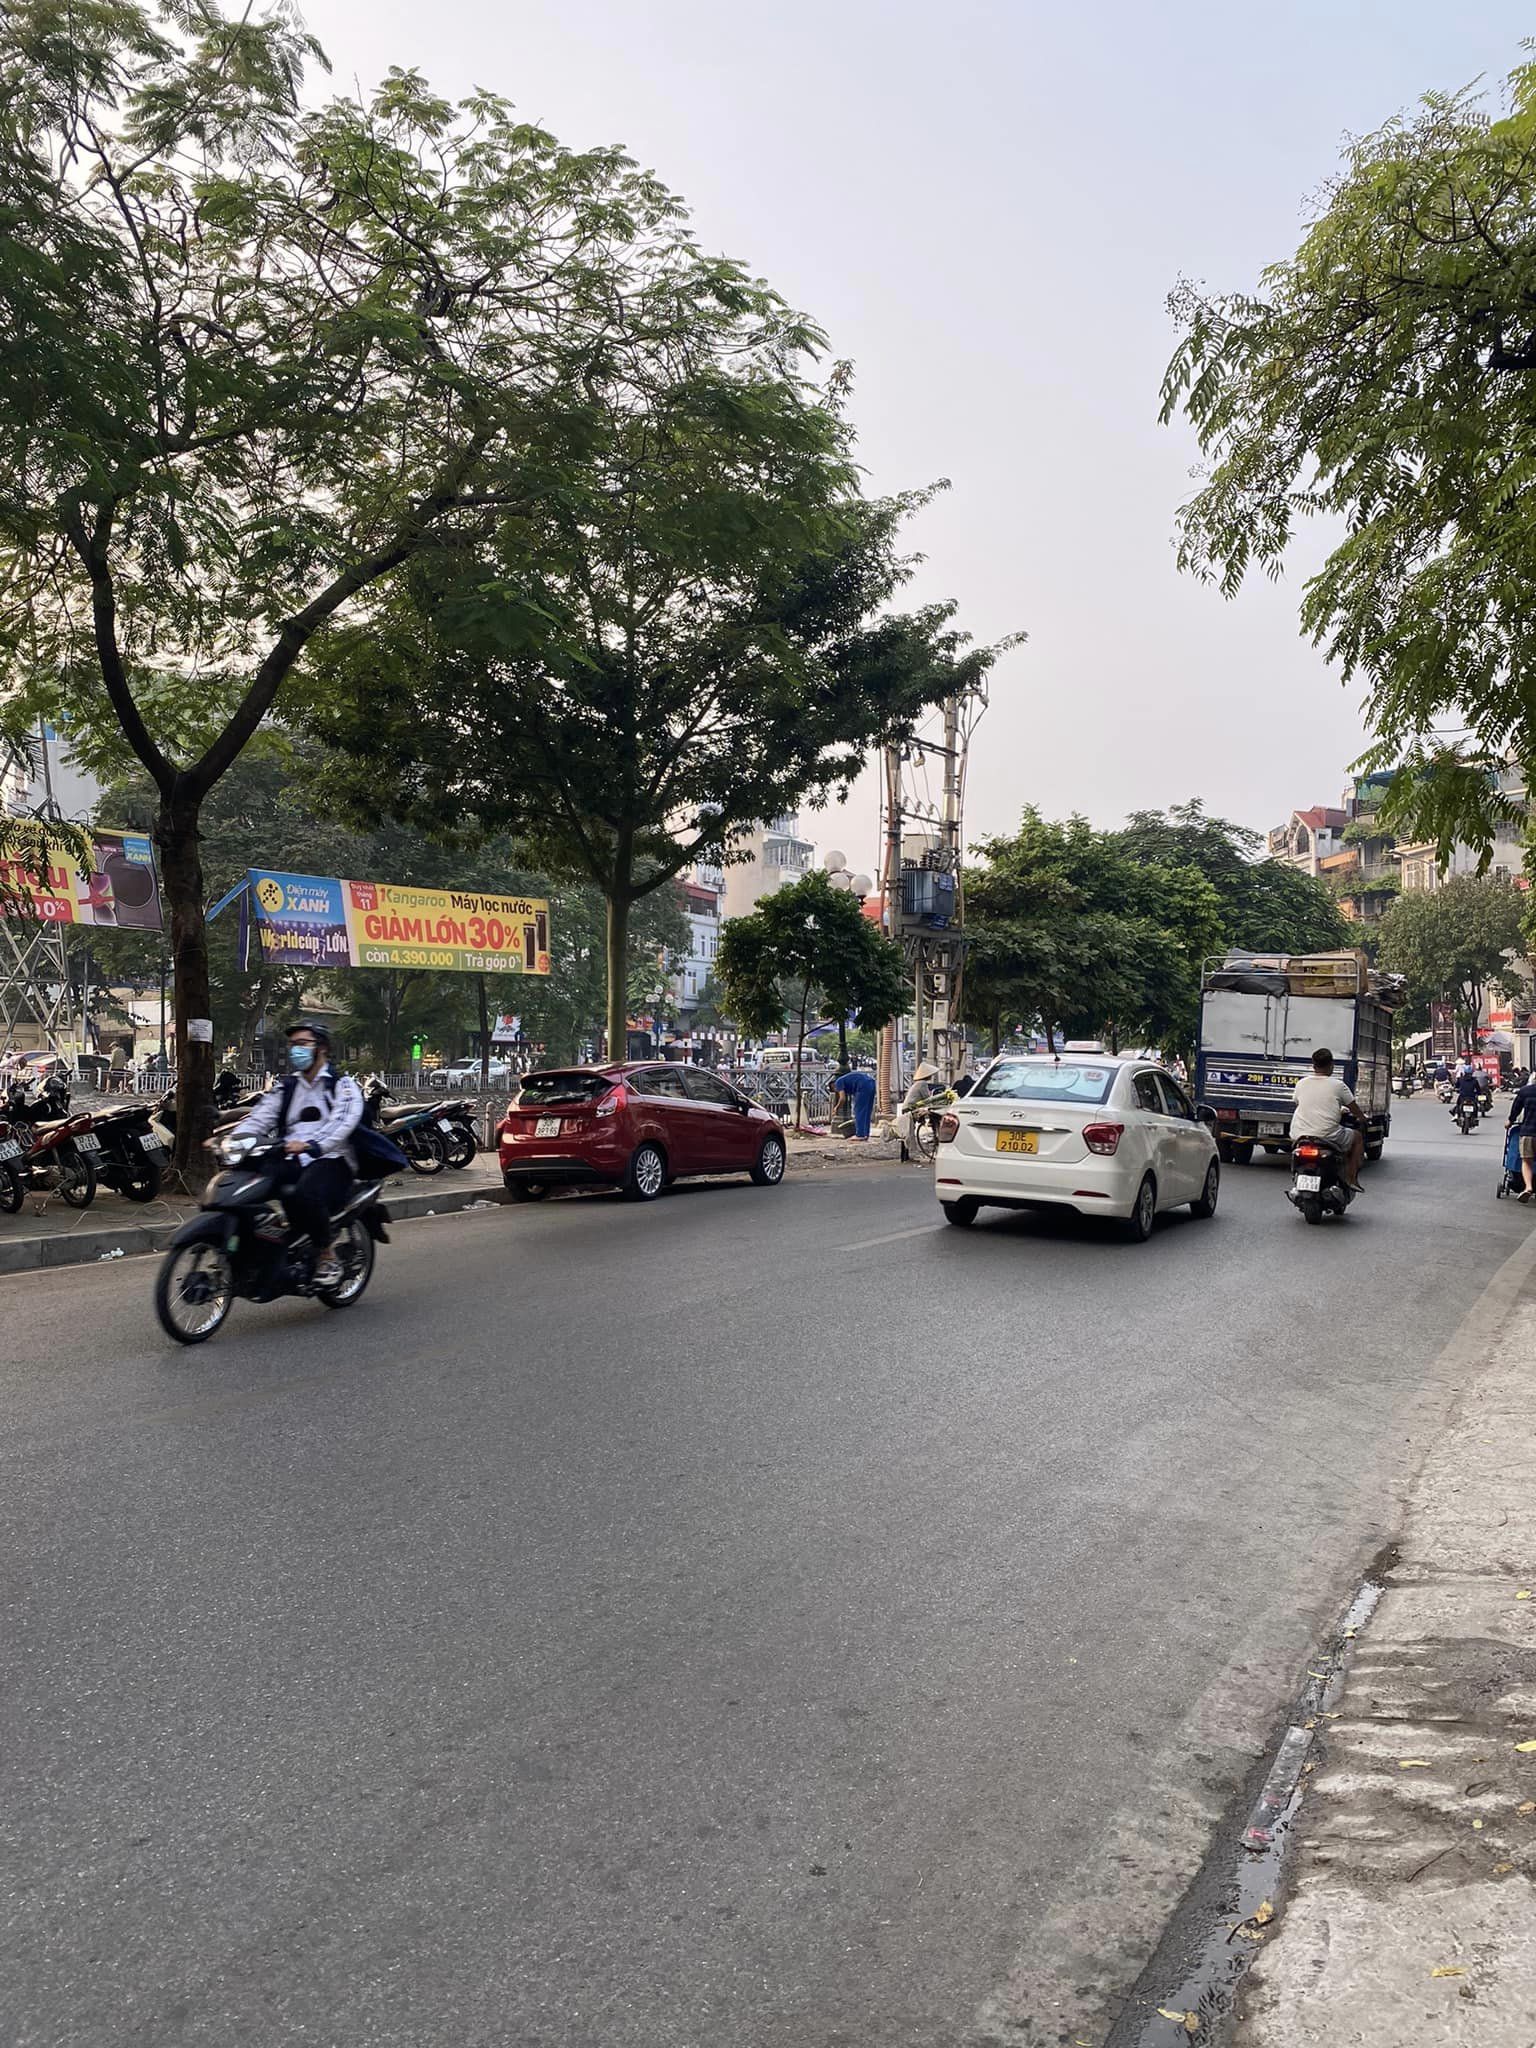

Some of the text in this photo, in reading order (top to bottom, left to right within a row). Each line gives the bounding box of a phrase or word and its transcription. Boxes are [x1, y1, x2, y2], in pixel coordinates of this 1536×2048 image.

[43, 900, 65, 917] 0%
[287, 896, 329, 913] XANH
[360, 898, 371, 910] 11
[380, 887, 533, 915] Kangaroo Máy lọc nước
[365, 908, 520, 950] GIẢM LỚN 30%
[366, 947, 390, 963] còn
[390, 949, 454, 966] 4.390.000
[465, 952, 484, 968] Trả
[485, 954, 507, 971] góp
[1009, 1132, 1026, 1141] 30E
[1000, 1142, 1033, 1152] 210.02
